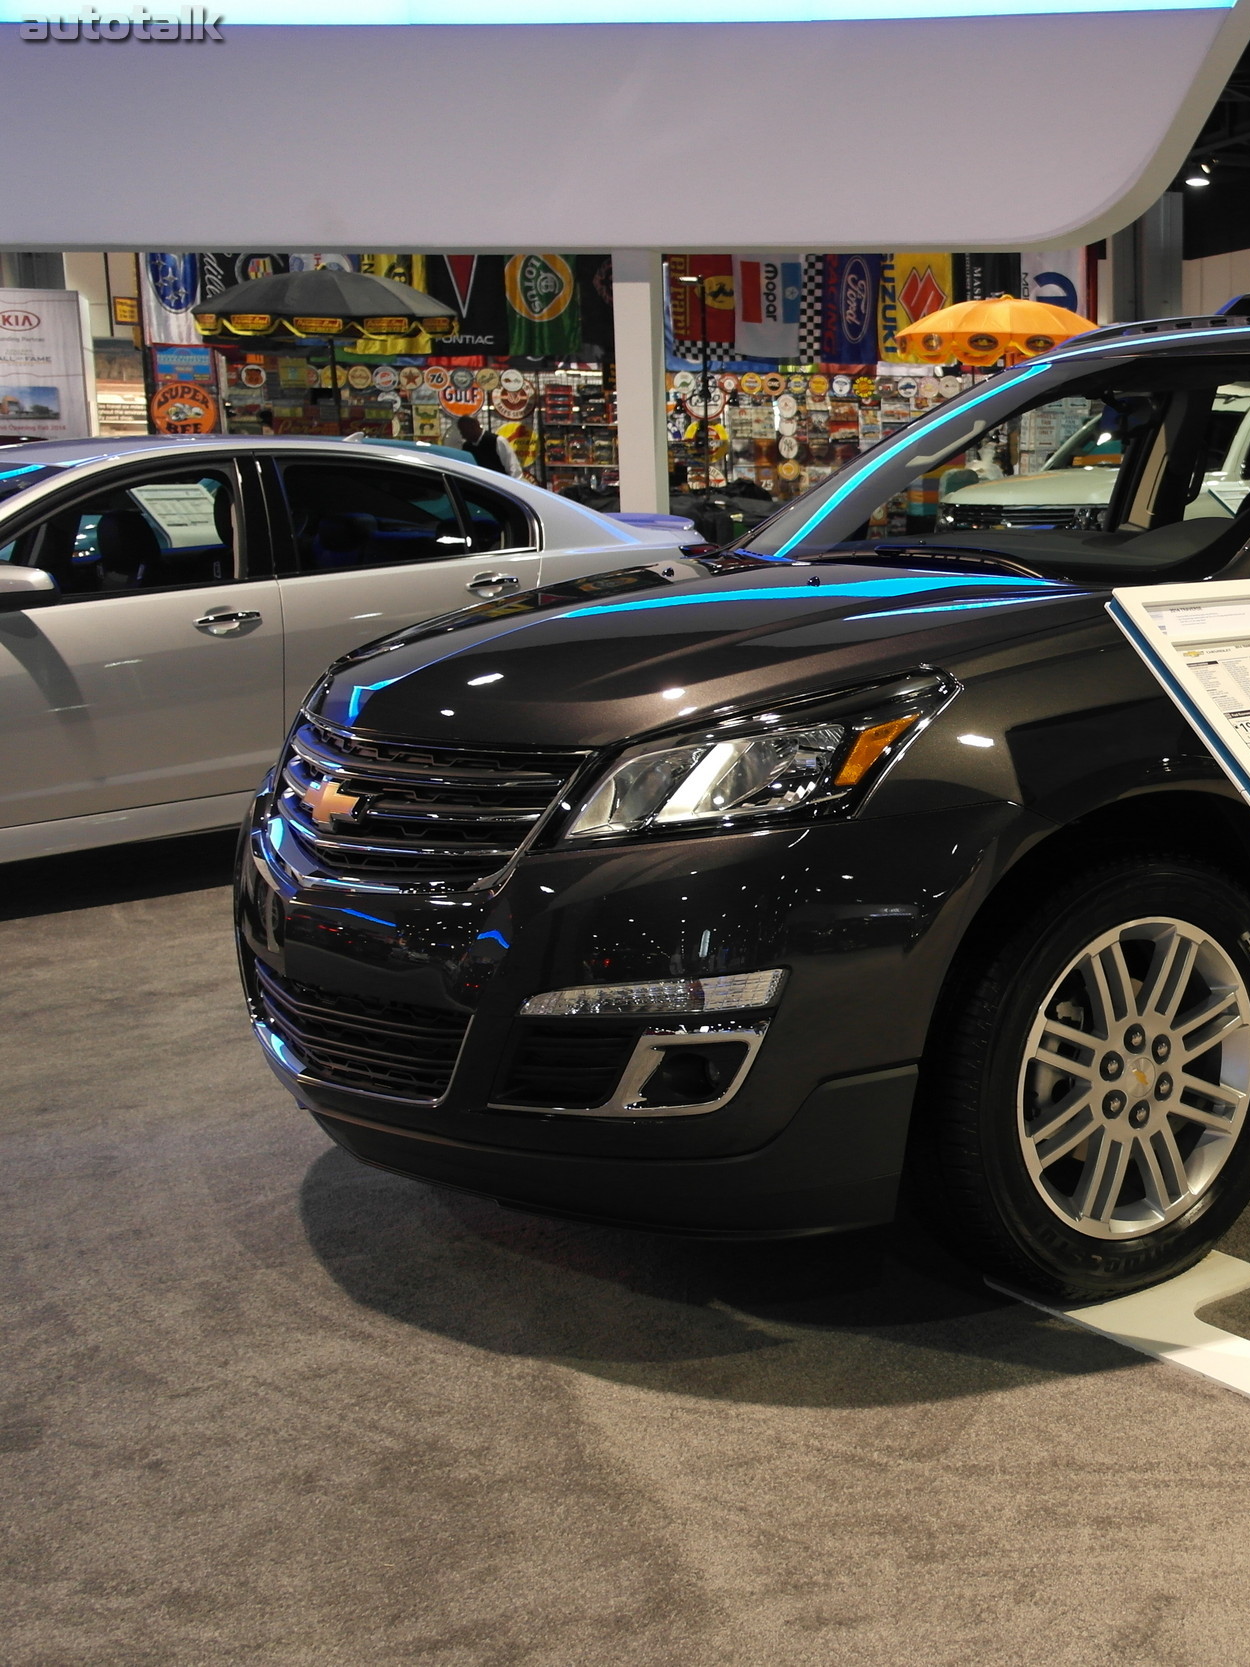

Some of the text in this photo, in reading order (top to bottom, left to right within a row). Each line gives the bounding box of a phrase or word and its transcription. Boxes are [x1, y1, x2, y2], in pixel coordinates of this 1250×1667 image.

[523, 258, 542, 313] LOTUS
[846, 274, 868, 326] Ford
[2, 315, 33, 327] KIA
[430, 372, 444, 384] 76
[157, 385, 209, 410] SUPER
[444, 387, 479, 405] GULF
[165, 422, 203, 434] BEE
